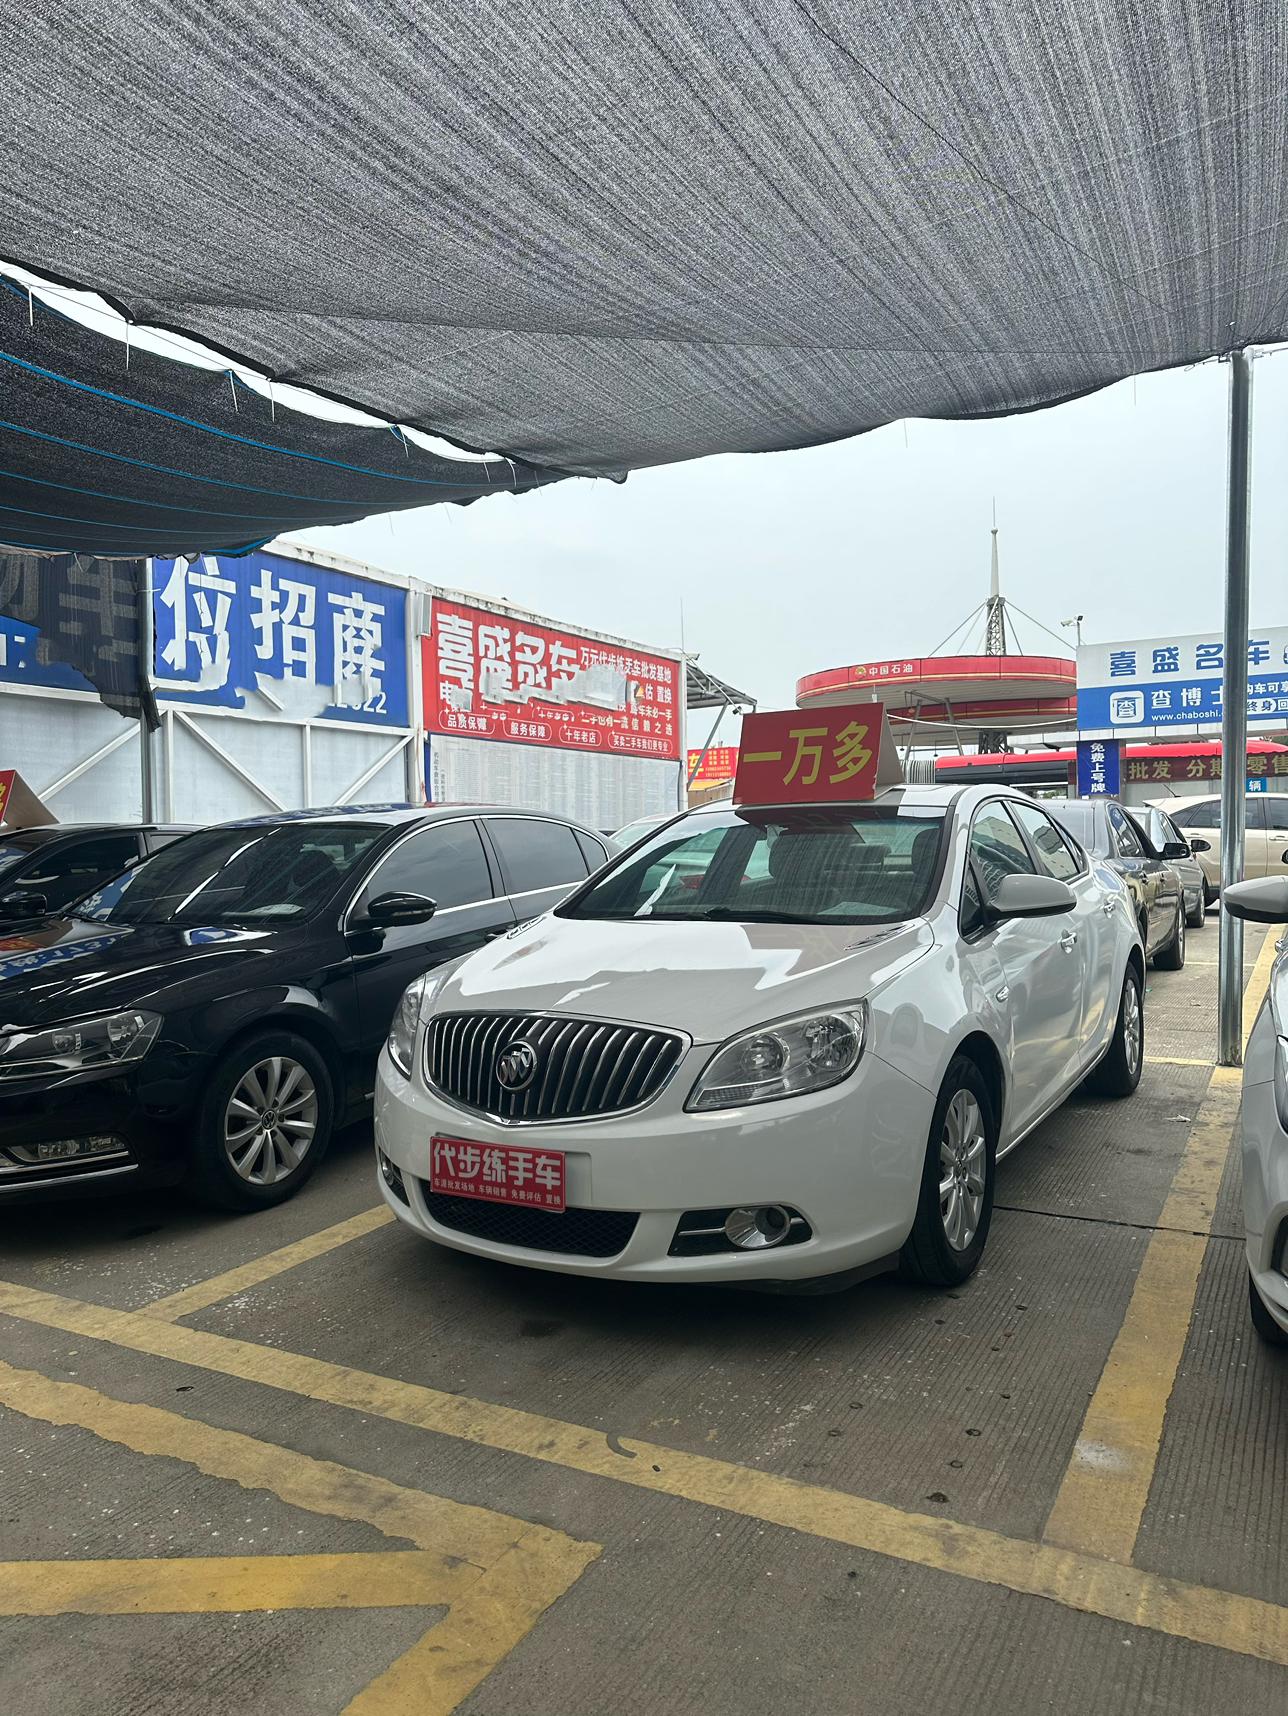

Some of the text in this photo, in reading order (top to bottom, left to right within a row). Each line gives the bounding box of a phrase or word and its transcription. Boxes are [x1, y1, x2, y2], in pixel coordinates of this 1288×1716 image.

[869, 664, 913, 676] 中国石油
[447, 714, 488, 731] 品质保障
[1151, 709, 1224, 721] www.chaboshi.
[510, 721, 546, 737] 服务保障
[565, 729, 596, 744] 十年老店
[743, 721, 873, 785] 一万多
[1090, 742, 1106, 793] 免费上号牌
[1129, 761, 1172, 779] 批发
[433, 1142, 562, 1190] 代步练手车
